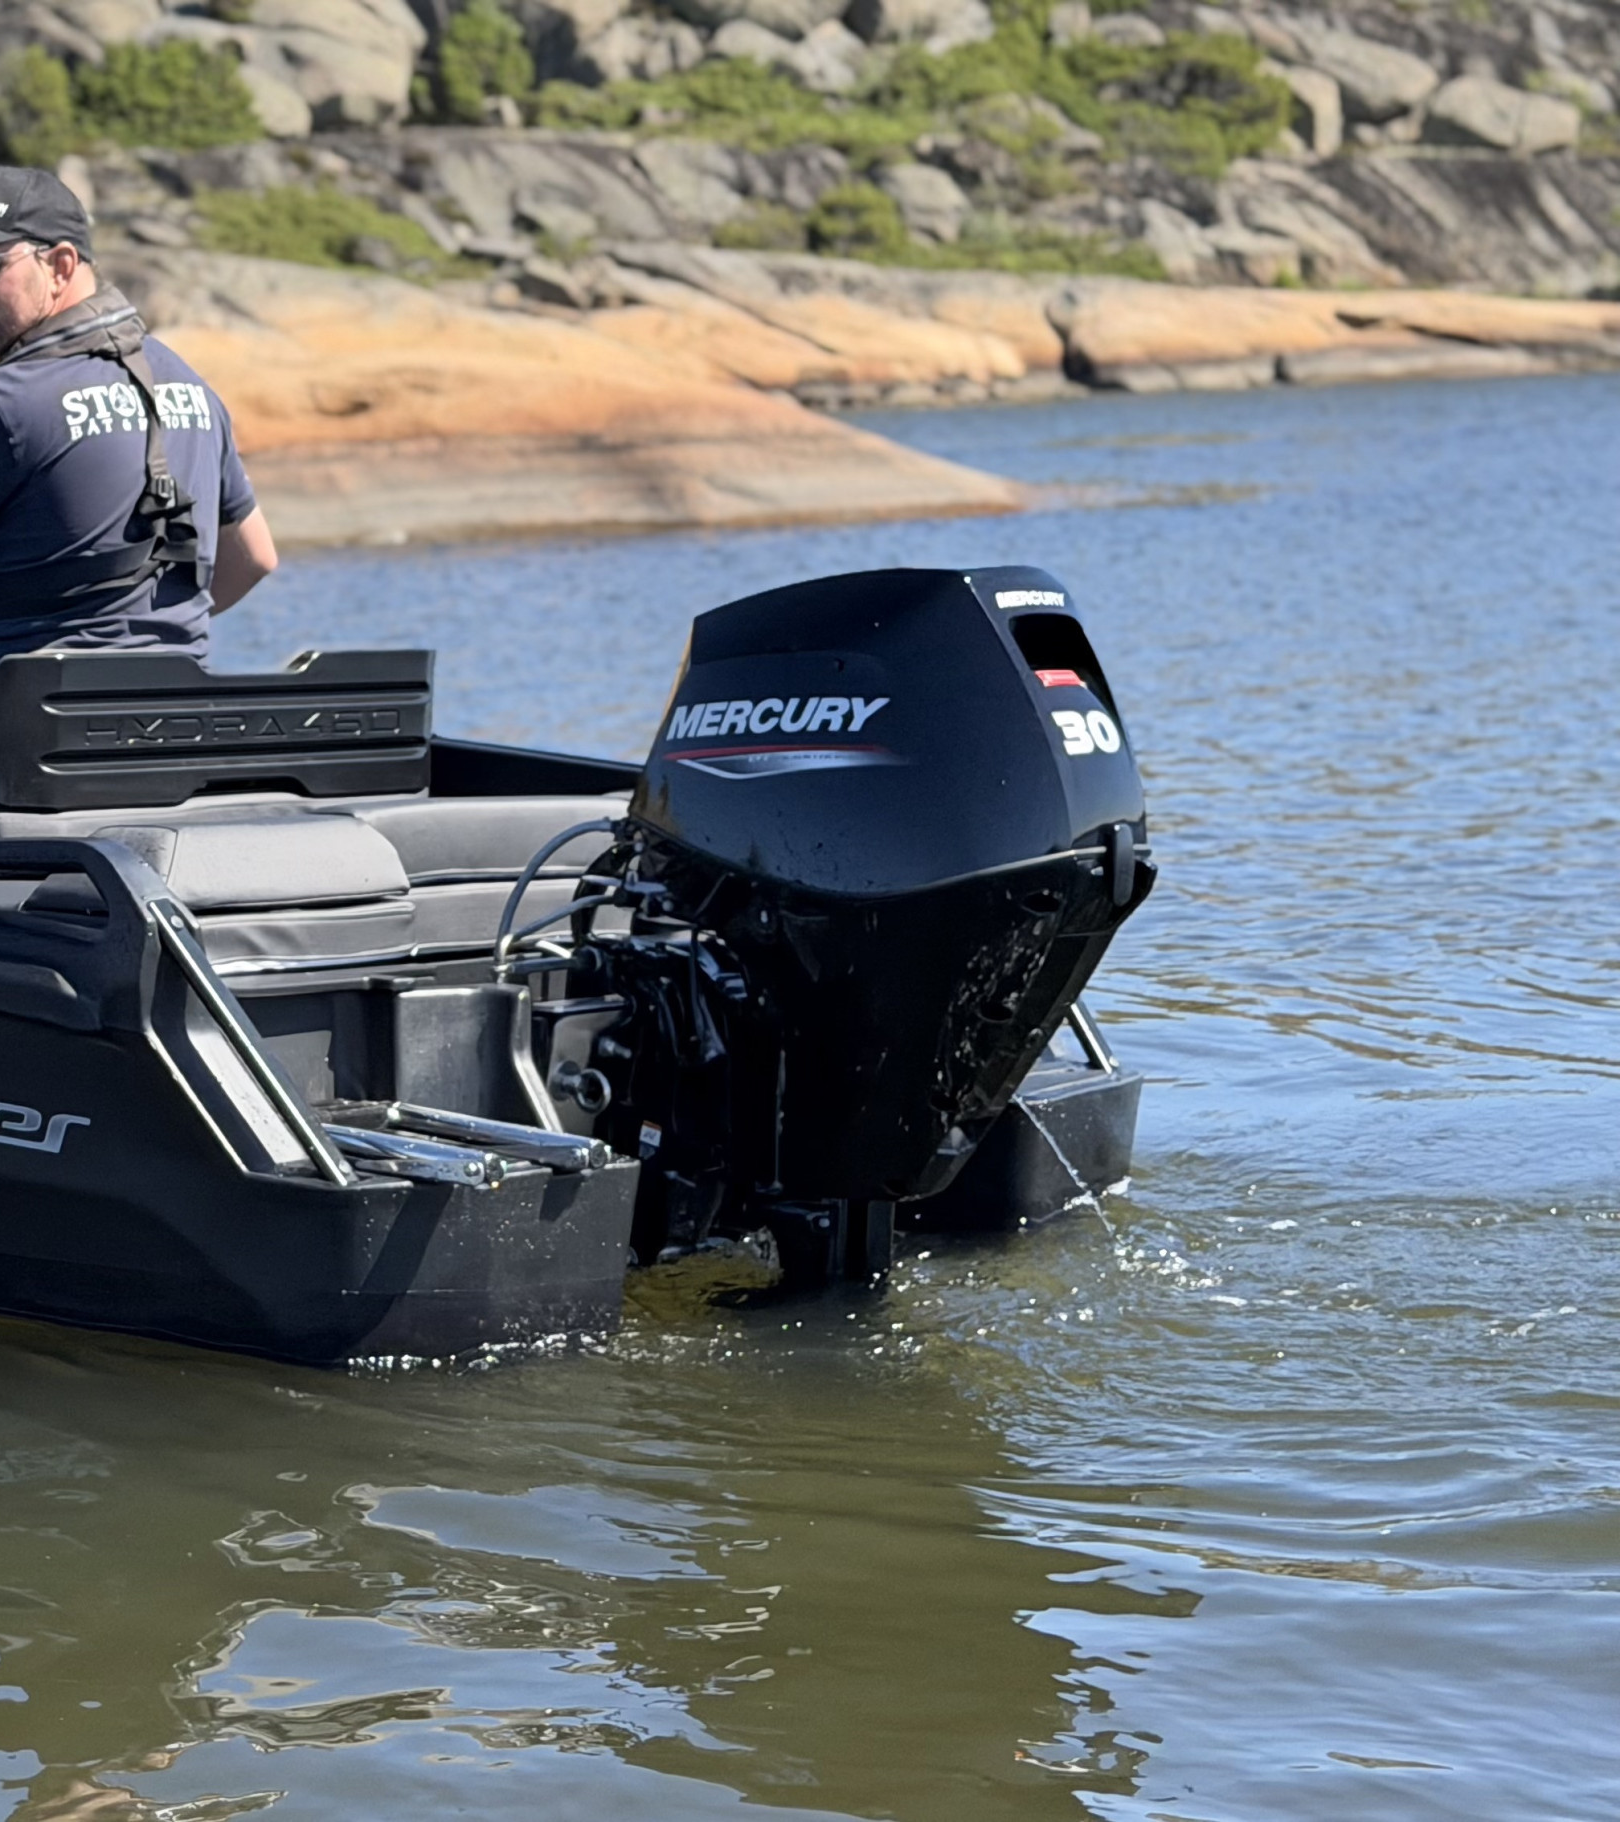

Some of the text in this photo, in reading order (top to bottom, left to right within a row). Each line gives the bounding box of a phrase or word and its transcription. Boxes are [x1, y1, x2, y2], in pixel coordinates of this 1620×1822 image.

[138, 415, 191, 431] MTOR
[666, 697, 890, 741] MERCURY
[1051, 710, 1121, 756] 30
